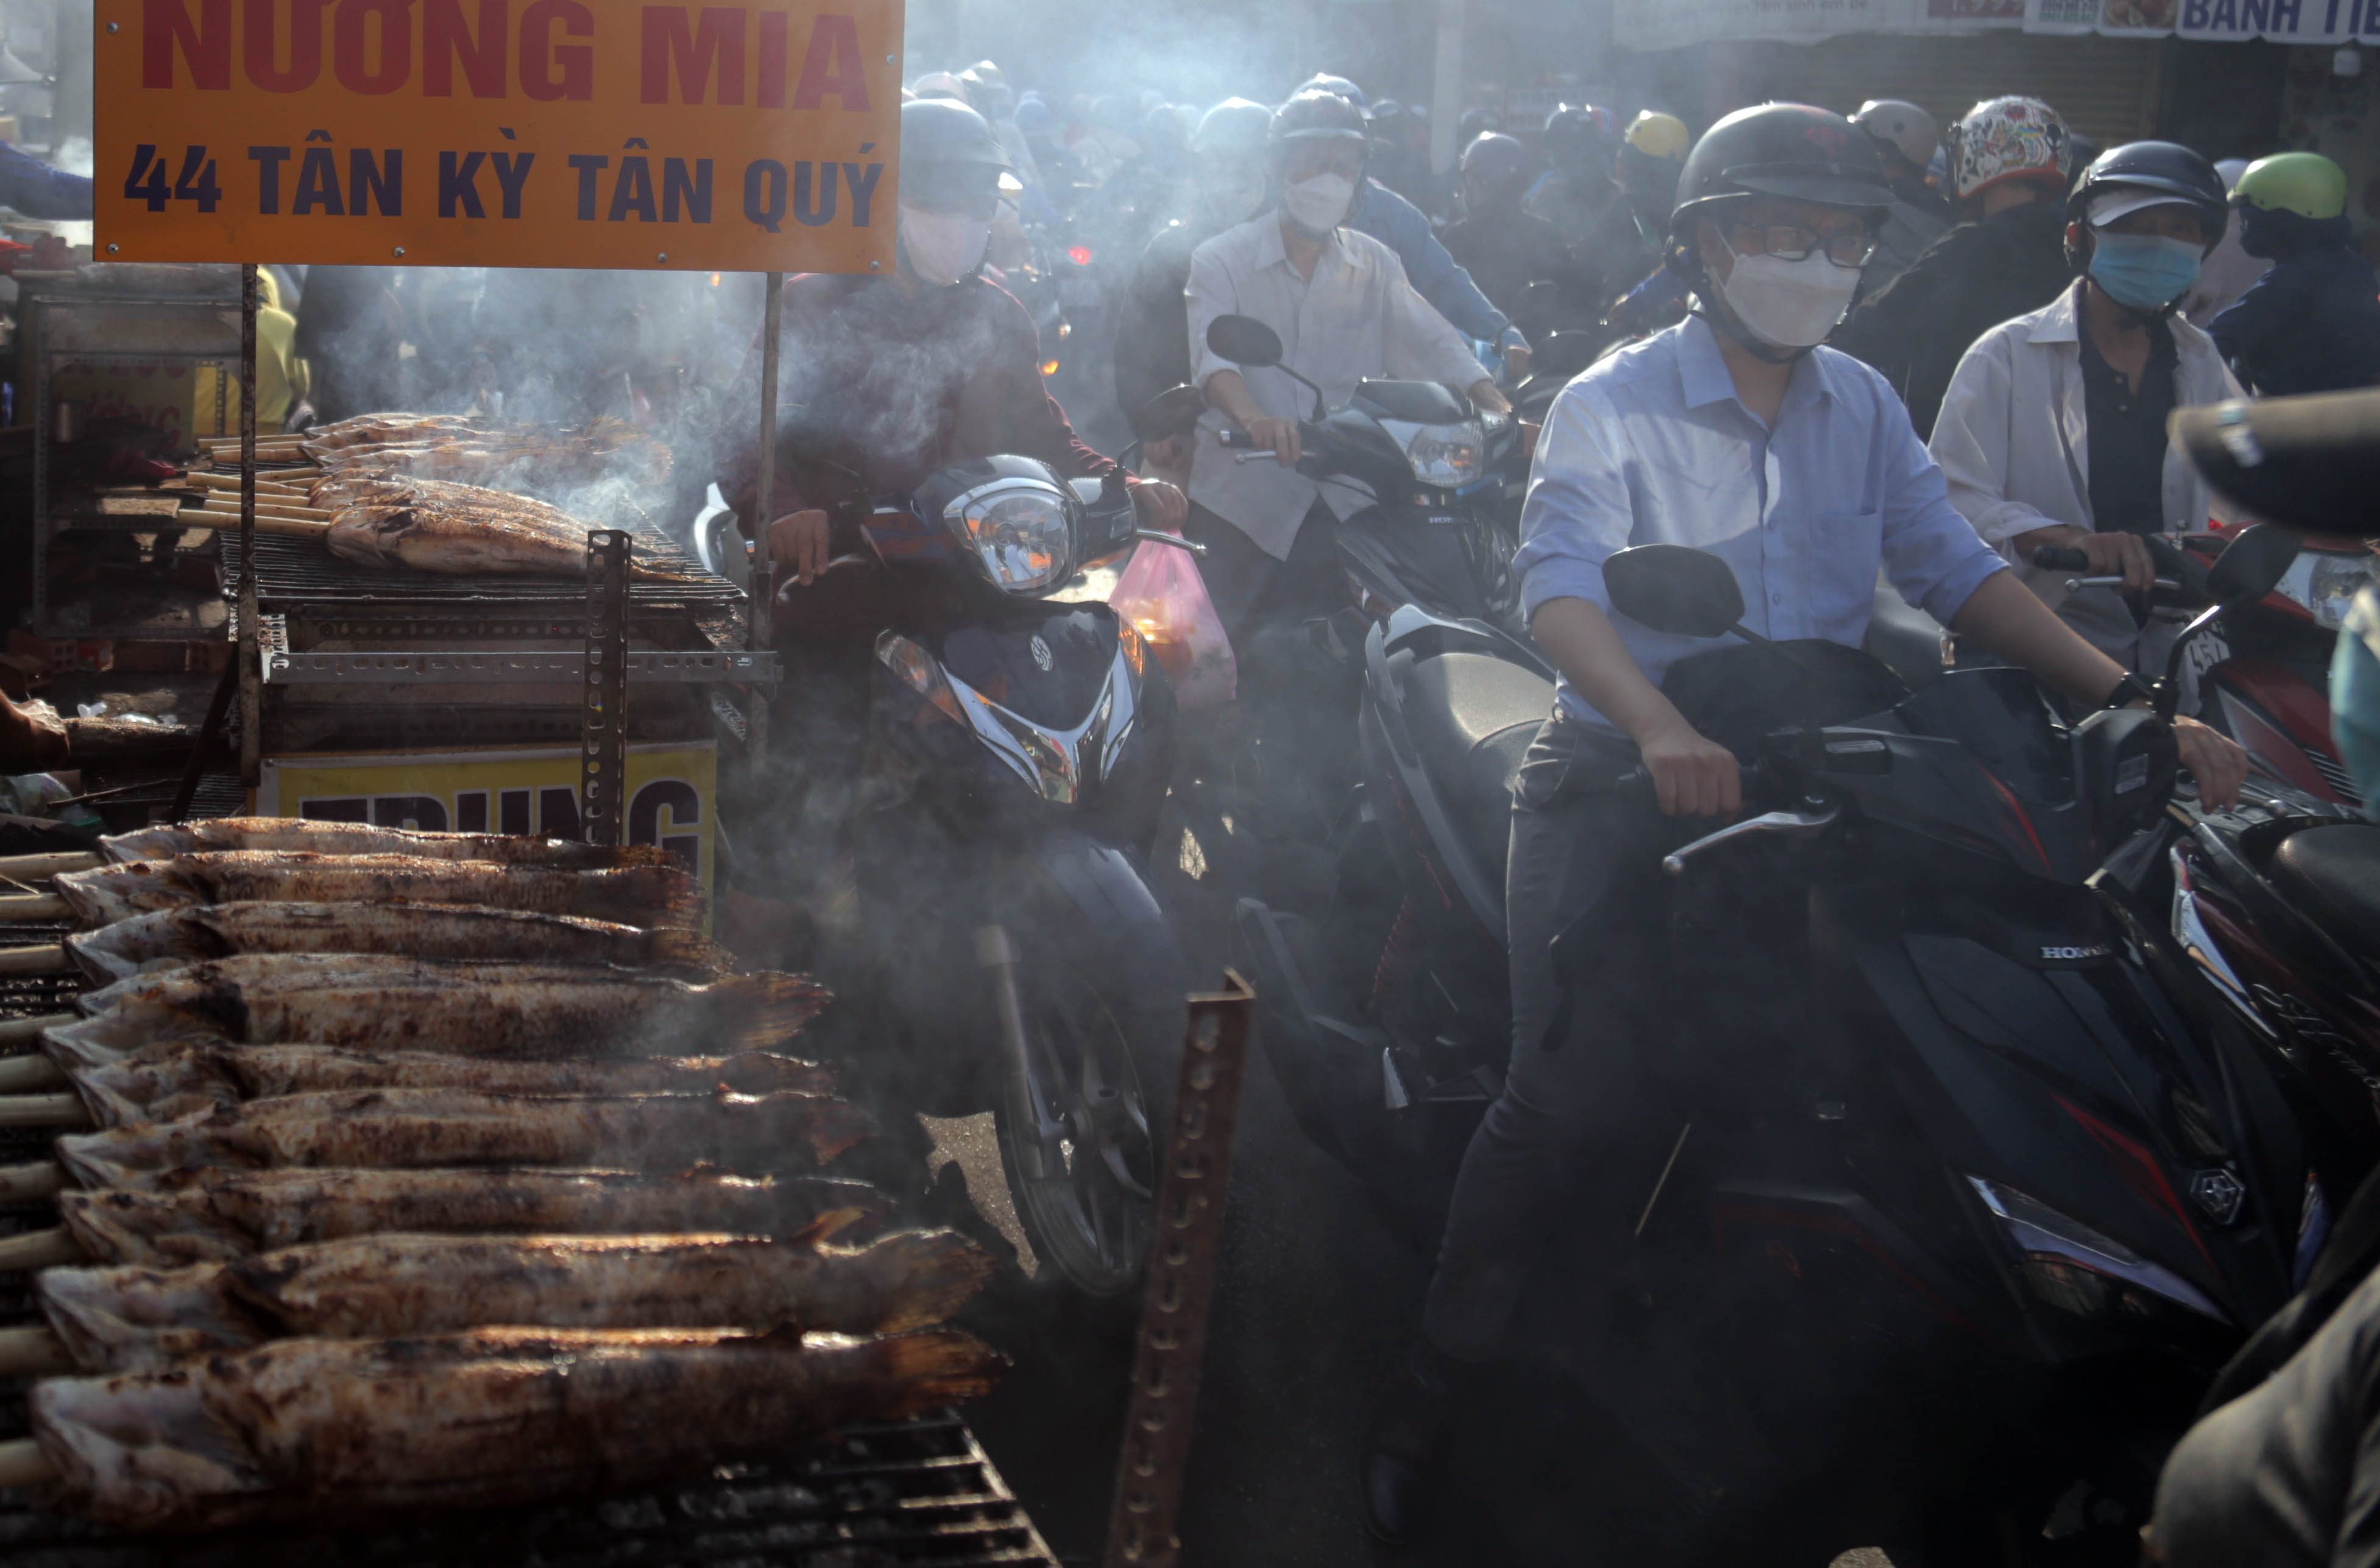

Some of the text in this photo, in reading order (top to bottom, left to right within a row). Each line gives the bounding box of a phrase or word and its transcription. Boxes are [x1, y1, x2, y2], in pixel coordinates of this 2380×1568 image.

[640, 5, 871, 113] MIA
[124, 127, 884, 233] 44 TÂN KỲ TÂN QUÝ
